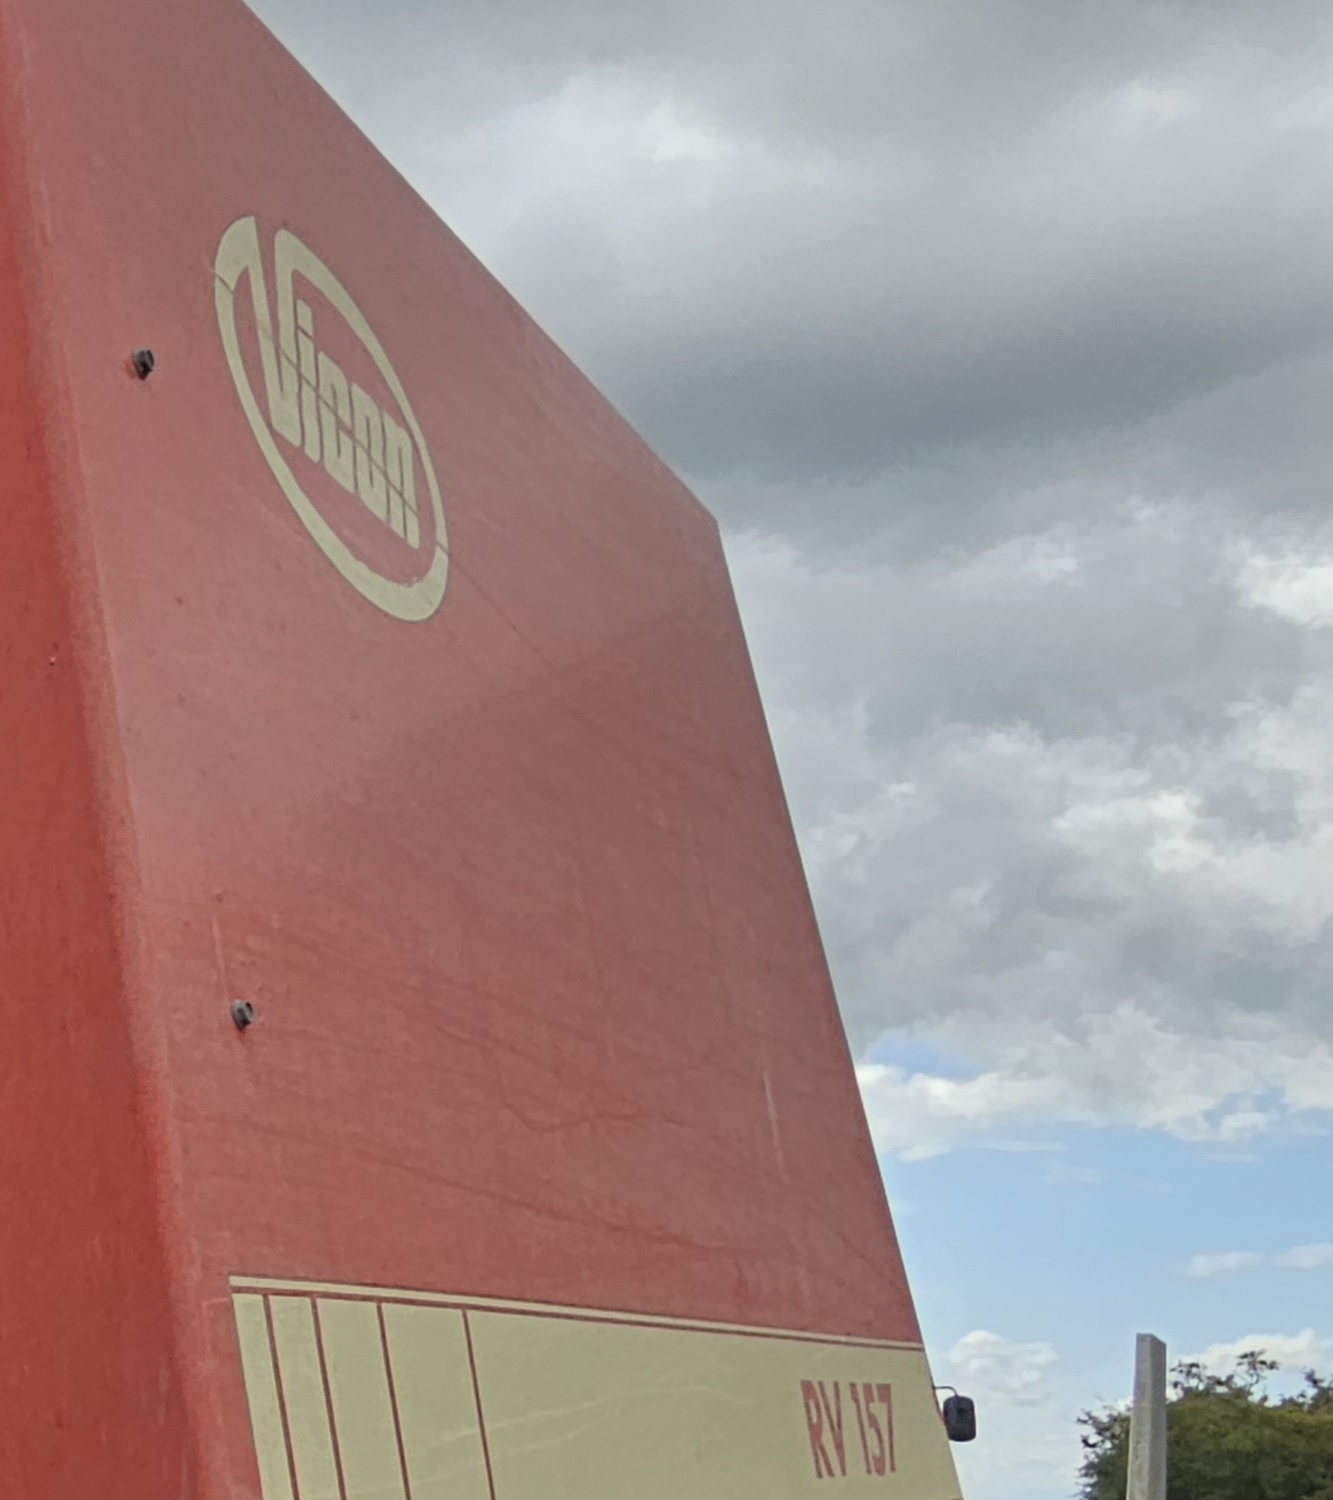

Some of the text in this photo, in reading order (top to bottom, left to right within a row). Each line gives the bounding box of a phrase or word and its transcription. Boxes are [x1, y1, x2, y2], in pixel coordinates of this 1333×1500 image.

[245, 216, 422, 550] Vicon
[800, 1379, 896, 1479] RV 157
